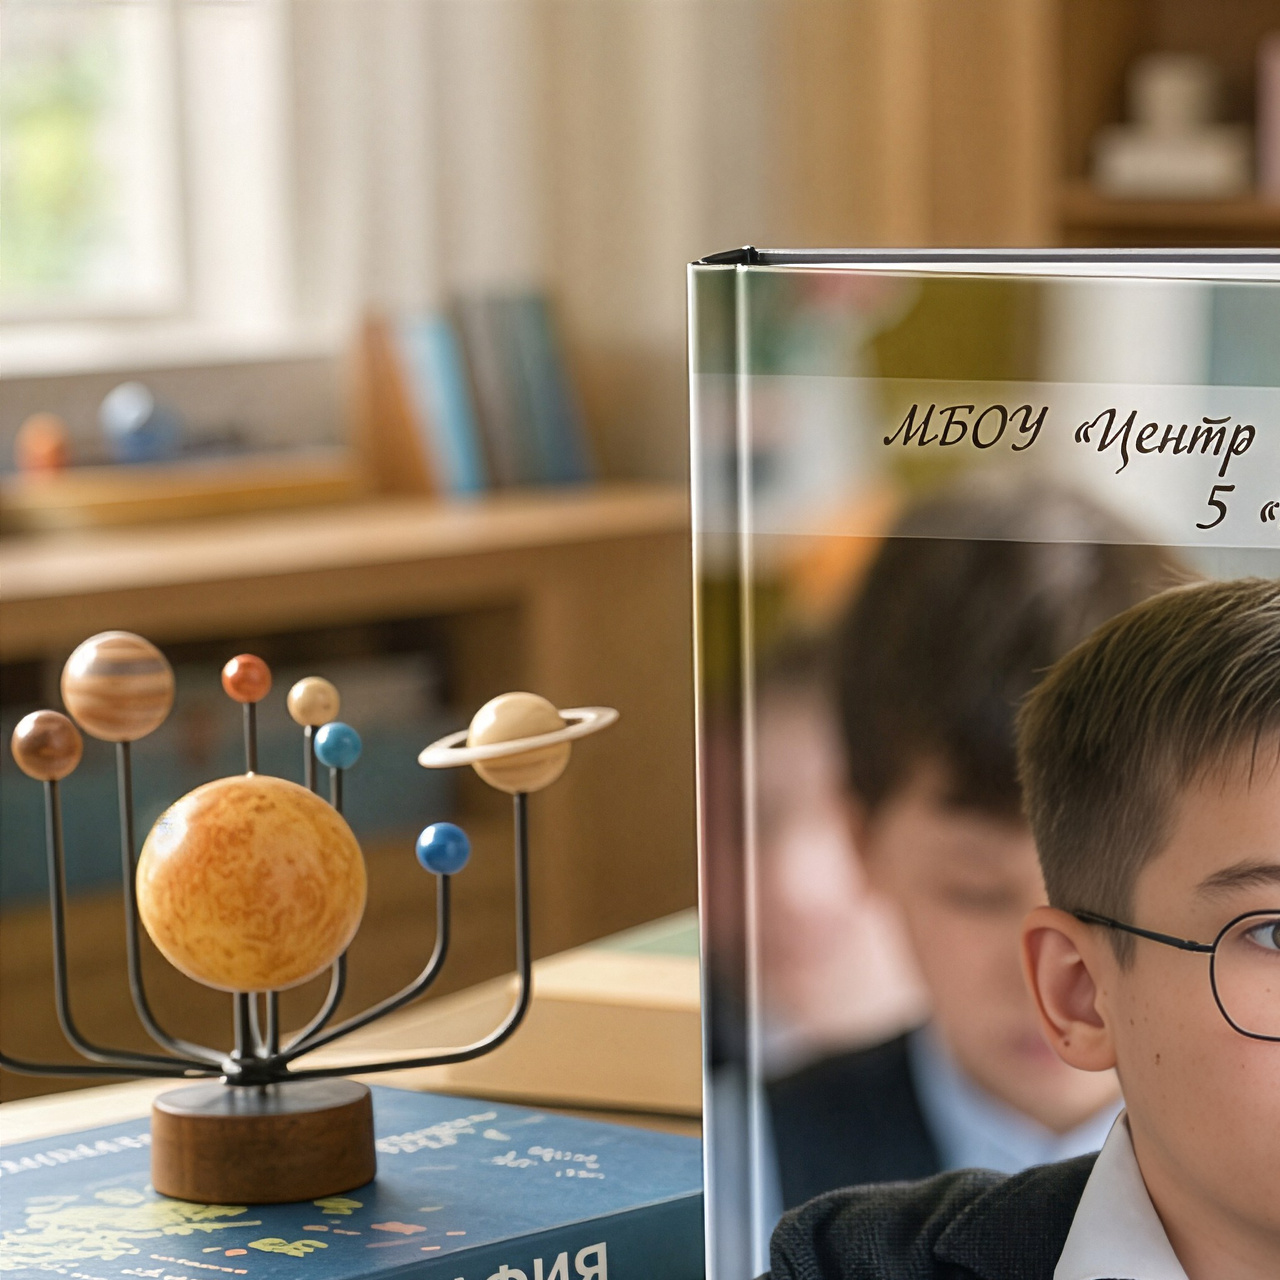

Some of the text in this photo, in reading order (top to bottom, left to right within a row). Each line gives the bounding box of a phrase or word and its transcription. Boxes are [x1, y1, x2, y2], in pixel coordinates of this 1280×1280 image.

[883, 403, 1050, 452] МБОУ
[1074, 406, 1256, 480] «Центр
[1195, 484, 1236, 531] 5
